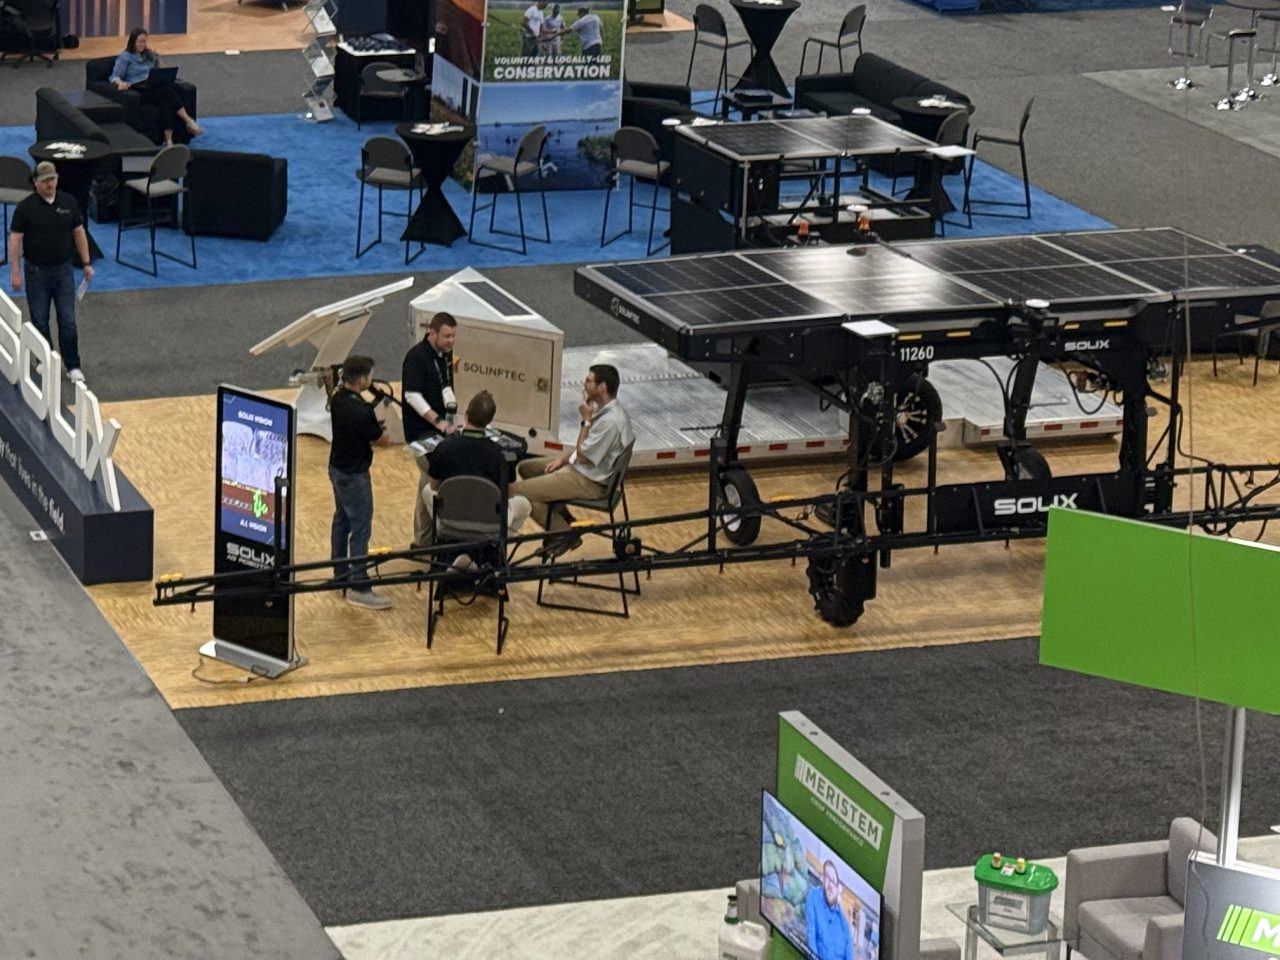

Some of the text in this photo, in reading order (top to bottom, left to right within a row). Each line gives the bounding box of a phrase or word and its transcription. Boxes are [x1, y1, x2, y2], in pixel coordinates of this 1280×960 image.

[494, 55, 545, 65] VOLUNTARY
[555, 54, 612, 64] LOCALLY-LED
[493, 65, 611, 79] CONSERVATION
[900, 345, 935, 361] 11260
[1064, 339, 1110, 352] SOLIX
[463, 361, 527, 383] SOLINFTEC
[5, 442, 17, 470] that
[18, 456, 31, 489] lives
[31, 474, 38, 498] in
[38, 484, 48, 512] the
[994, 493, 1079, 516] SOLIX
[226, 542, 276, 566] SOLIX
[805, 766, 879, 844] MERISTEM
